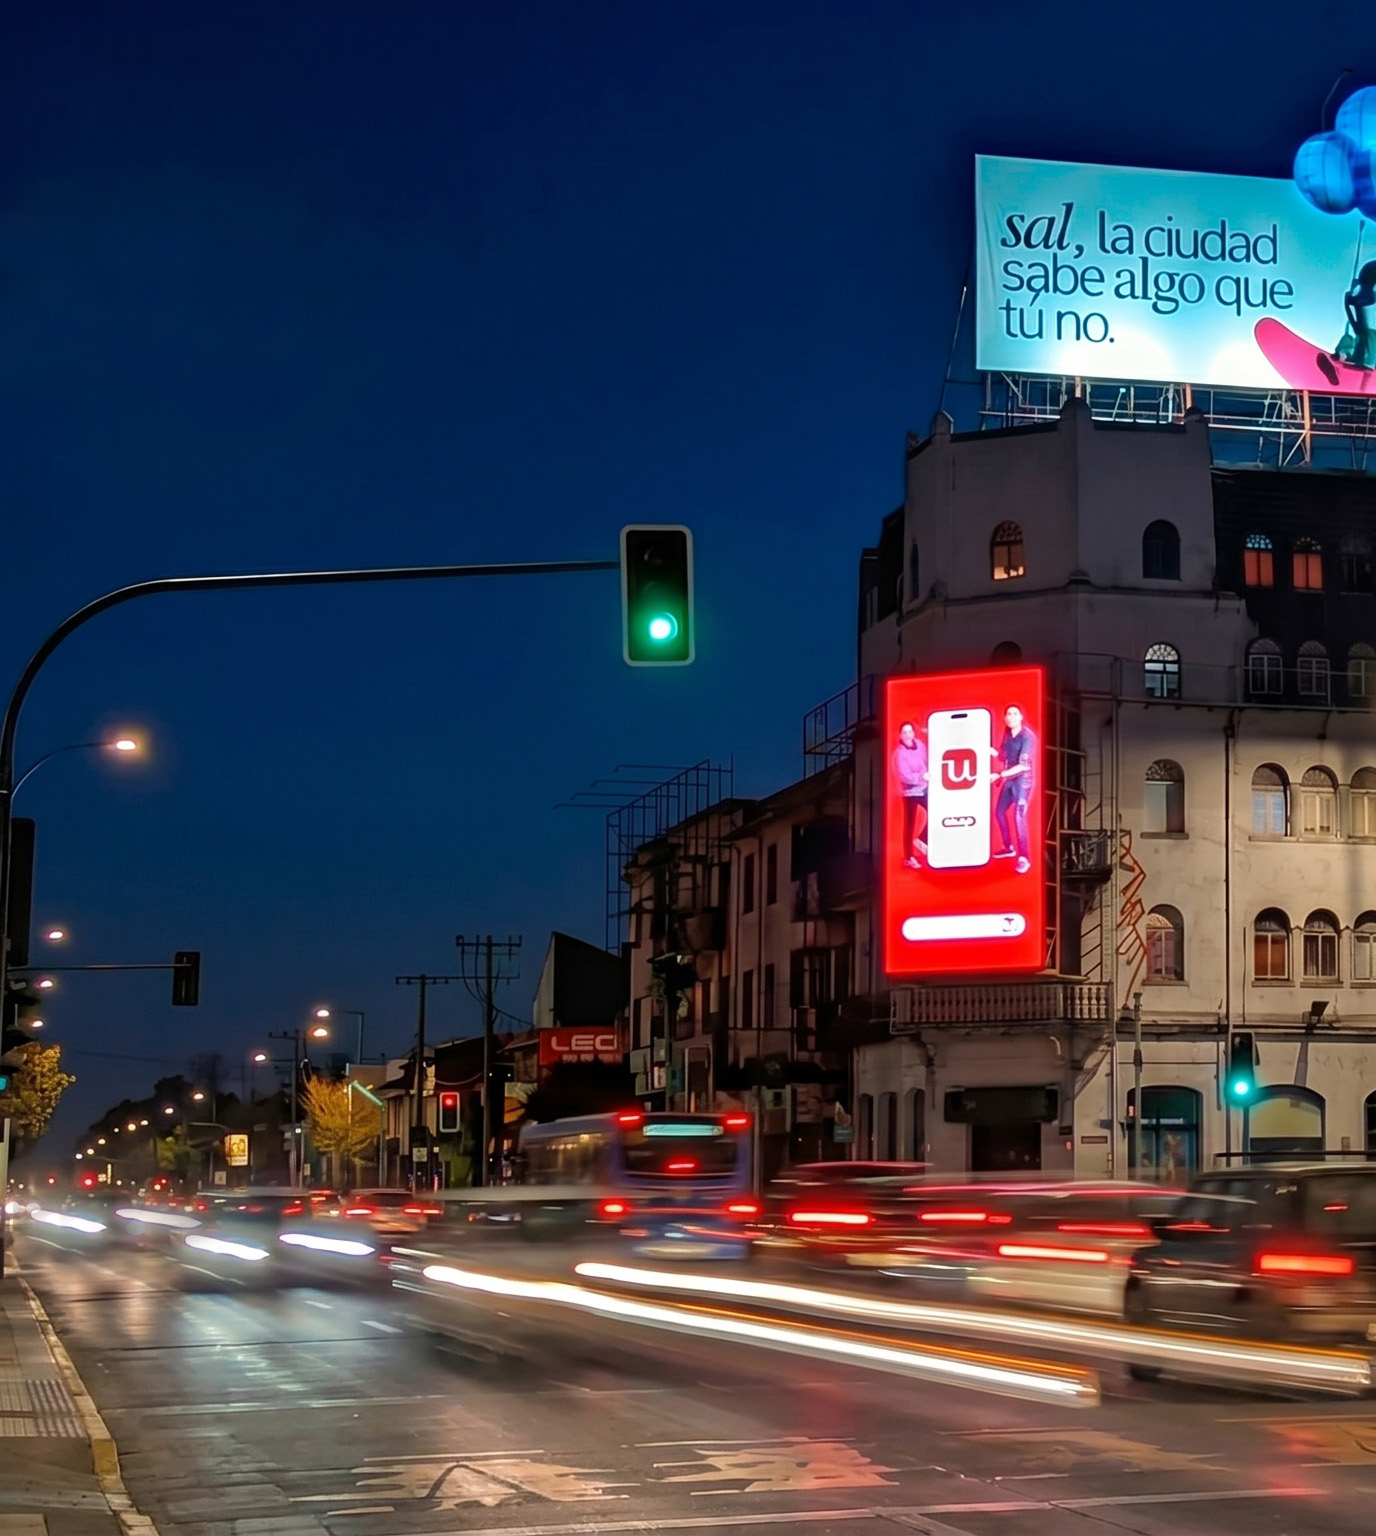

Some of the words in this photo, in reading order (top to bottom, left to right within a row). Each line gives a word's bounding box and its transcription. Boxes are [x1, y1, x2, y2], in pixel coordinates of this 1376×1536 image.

[1000, 202, 1085, 259] sal,
[1098, 210, 1134, 255] la
[1144, 215, 1278, 265] ciudad
[1002, 253, 1105, 297] sabe
[1113, 256, 1205, 315] algo
[1214, 275, 1294, 317] que
[998, 290, 1043, 340] tú
[1056, 309, 1115, 344] no.
